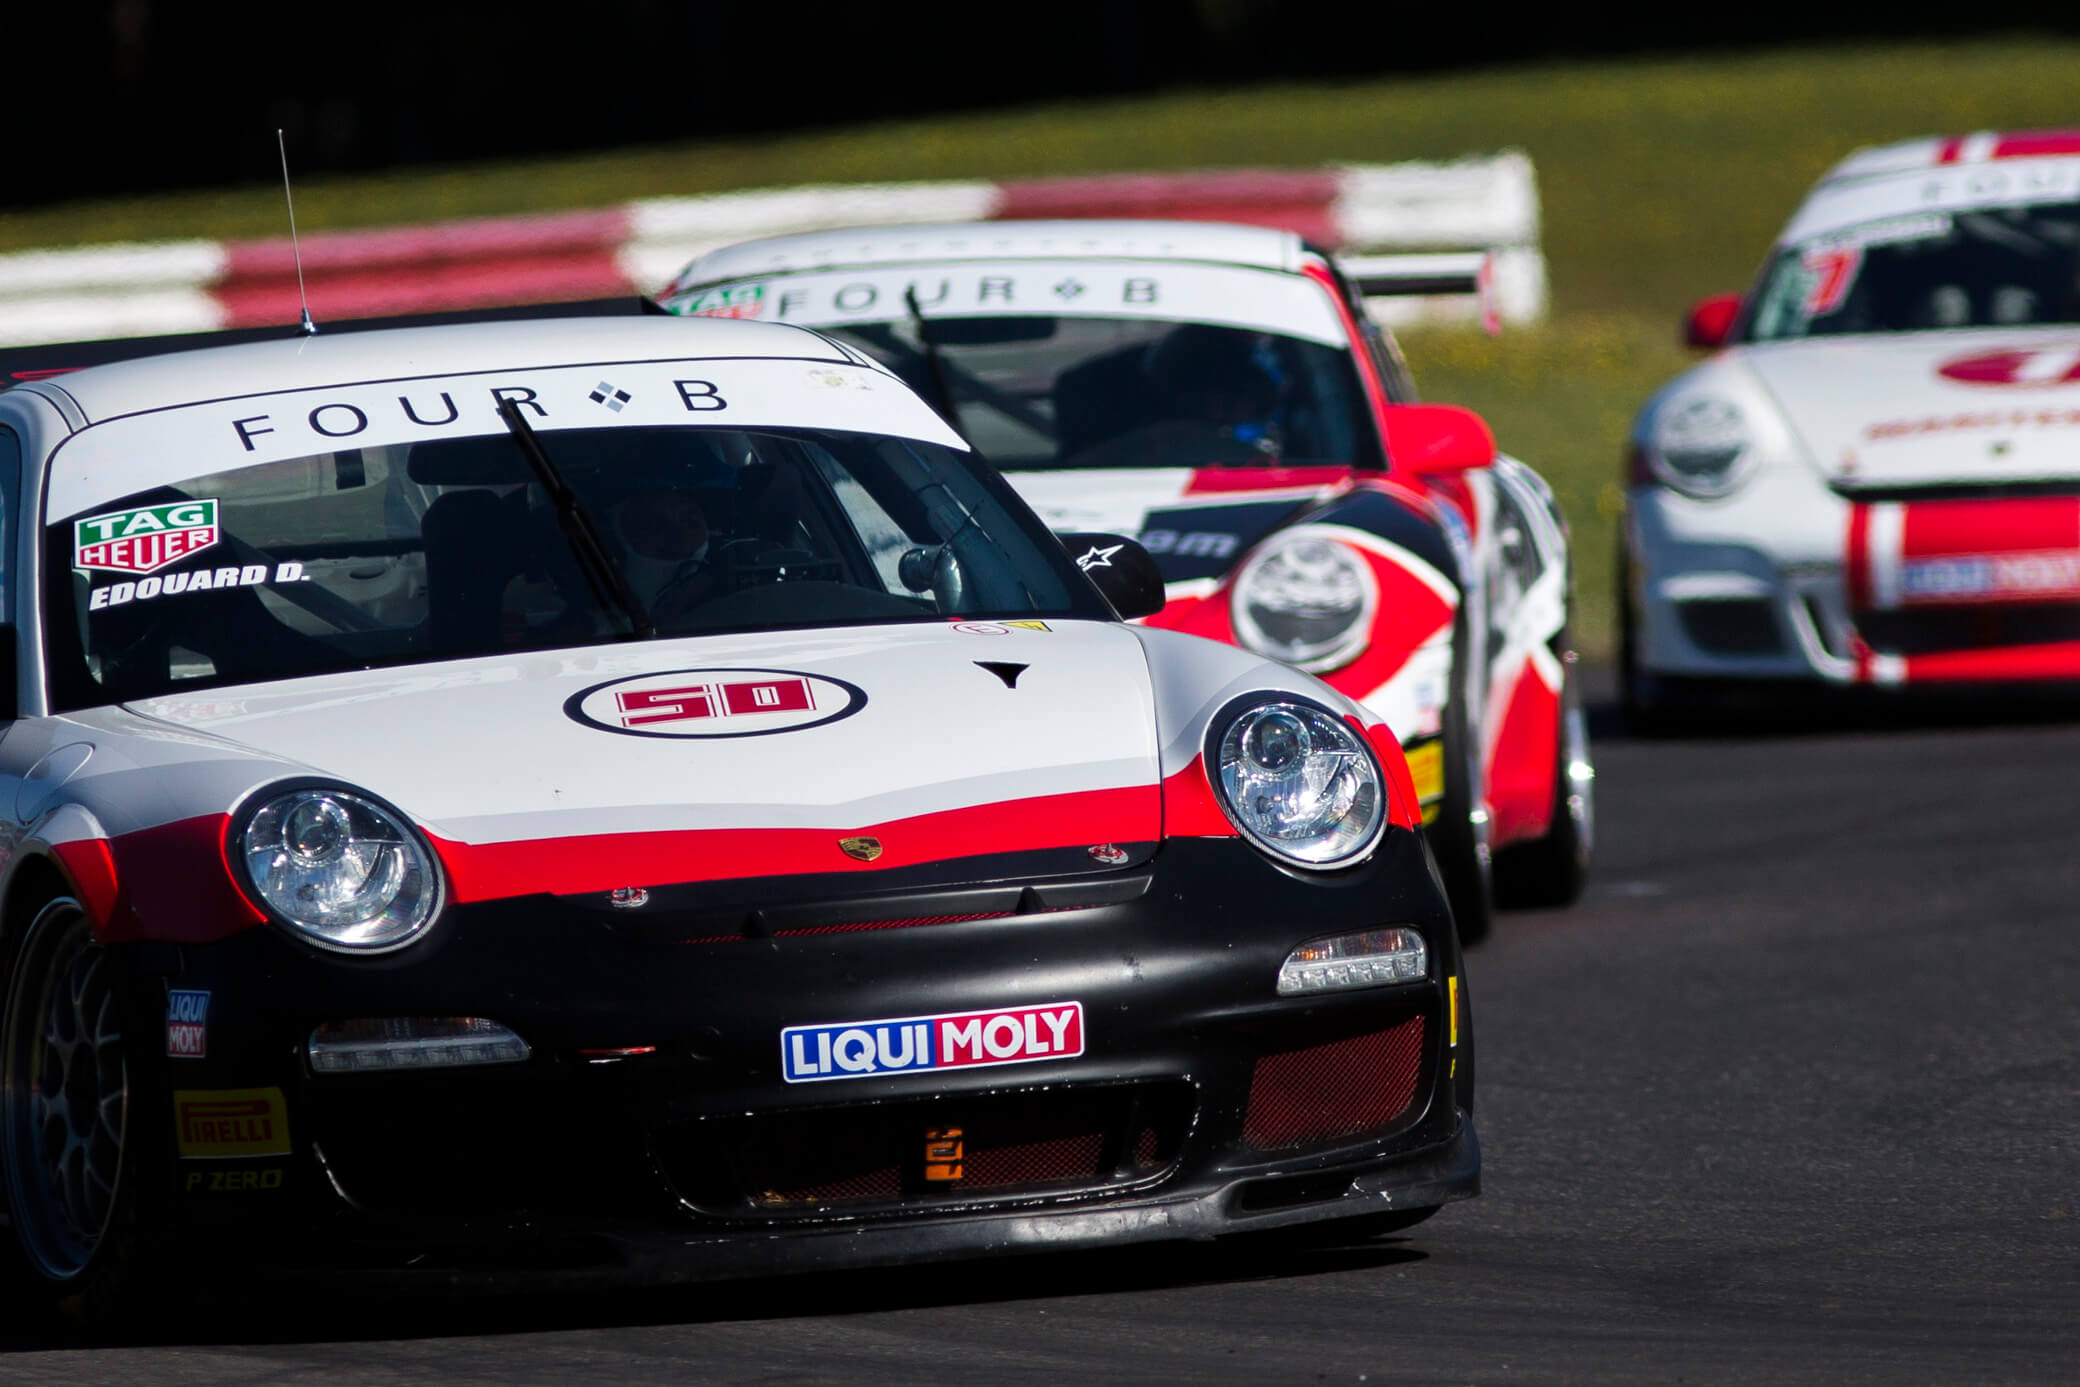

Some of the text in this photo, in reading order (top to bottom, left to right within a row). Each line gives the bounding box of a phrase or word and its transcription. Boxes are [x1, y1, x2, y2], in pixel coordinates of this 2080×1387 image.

[778, 275, 1016, 319] FOUR
[1122, 277, 1160, 304] B
[231, 379, 728, 452] FOUR B
[86, 505, 206, 541] TAG
[83, 529, 210, 569] HEUER
[88, 563, 311, 611] EDOUARD D.
[615, 677, 817, 727] 50
[169, 994, 209, 1023] LIQUI
[168, 1025, 203, 1053] MOLY
[791, 1009, 1075, 1075] LIQUI MOLY
[180, 1099, 273, 1144] PIRELLI
[186, 1168, 283, 1192] P ZERO
